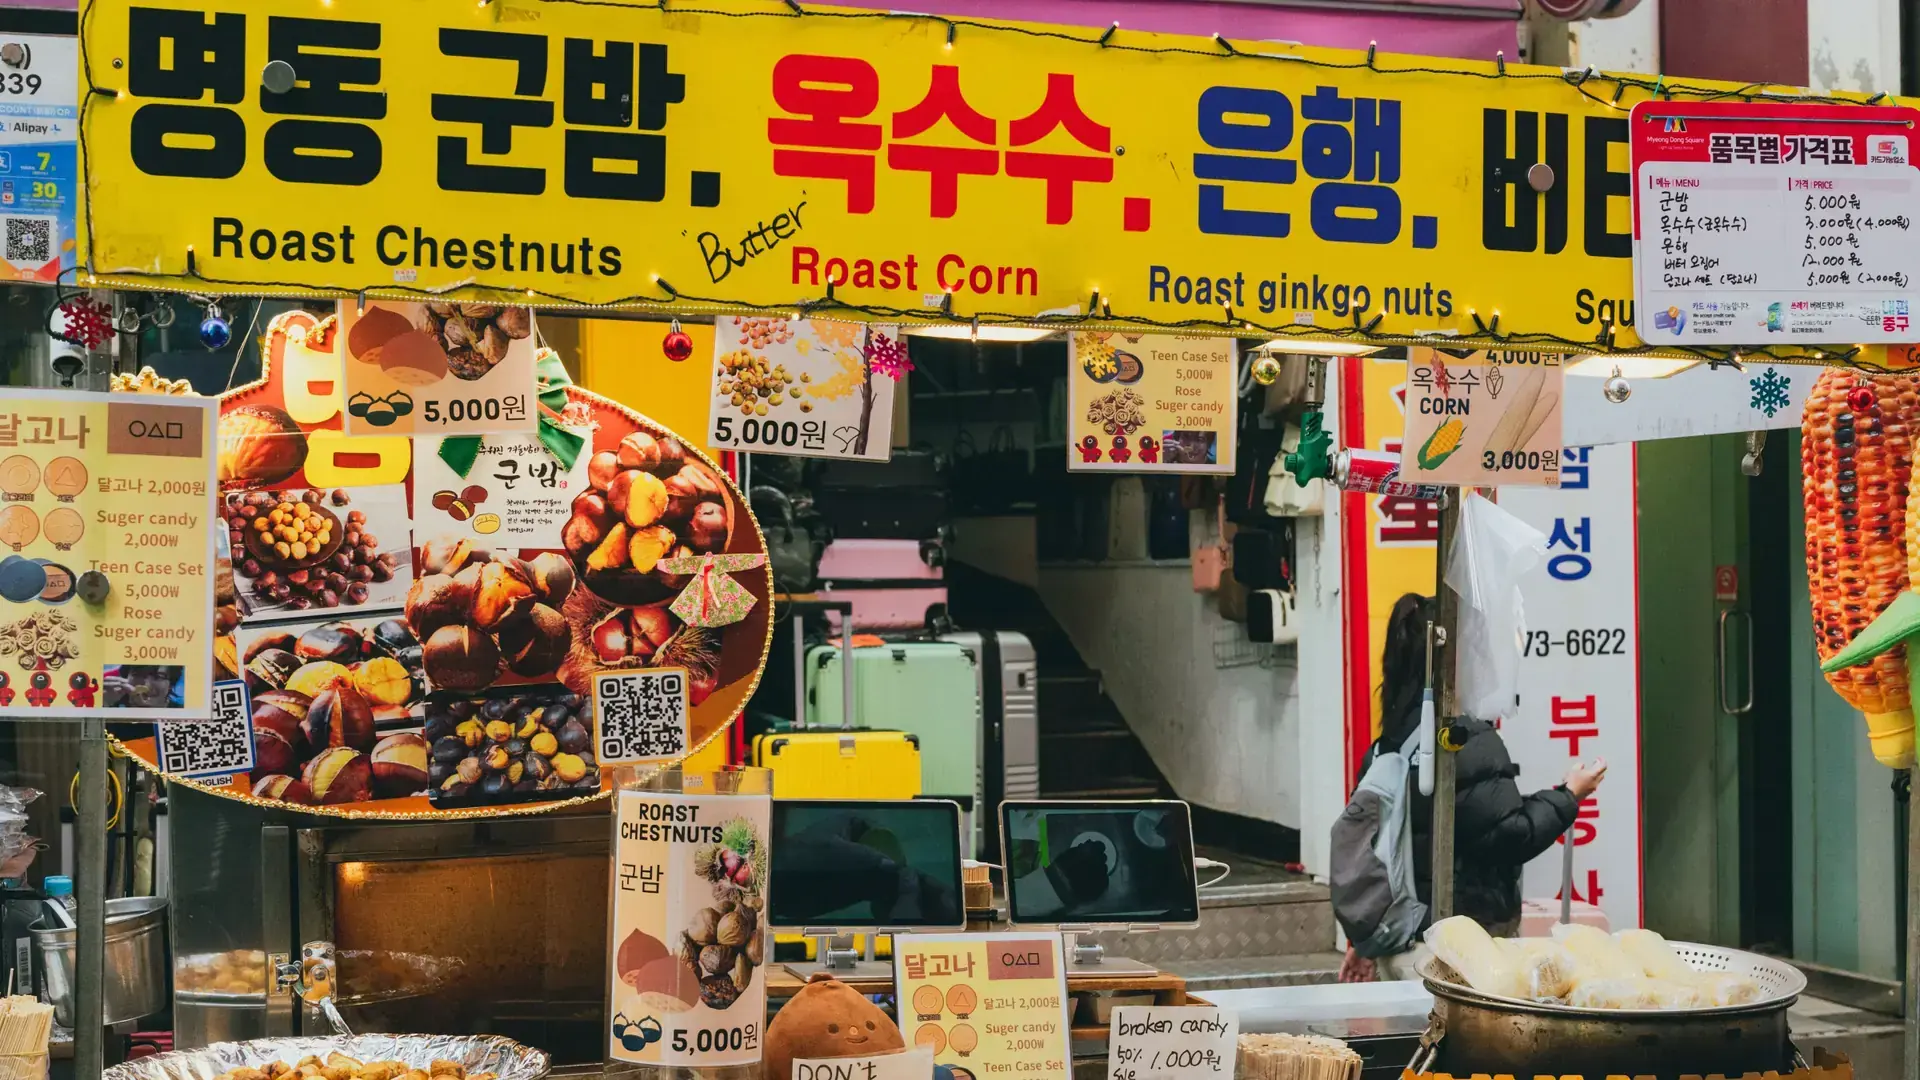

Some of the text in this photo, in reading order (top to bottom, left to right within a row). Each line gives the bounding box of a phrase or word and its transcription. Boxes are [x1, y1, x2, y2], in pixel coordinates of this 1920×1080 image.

[128, 5, 388, 187] 명동
[13, 122, 48, 134] Alipay
[1646, 136, 1669, 144] Myeong
[1710, 135, 1853, 166] 품목별 가격표
[37, 152, 51, 171] 7
[32, 181, 57, 198] 30
[1656, 178, 1700, 188] 메뉴 MENU
[1795, 180, 1833, 190] 가격 PRICE
[1659, 191, 1689, 213] 군밤
[212, 216, 623, 277] Roast Chestnuts
[1661, 235, 1688, 255] 은행
[791, 245, 1040, 297] Roast Corn
[1664, 255, 1720, 271] 버터 오징어
[1149, 265, 1453, 319] Roast ginkgo nuts
[1882, 316, 1910, 332] 중구
[1150, 350, 1229, 363] Teen Case Set
[1174, 385, 1202, 396] Rose
[424, 394, 527, 425] 5,000원
[1155, 400, 1224, 414] Suger candy
[1419, 397, 1470, 416] CORN
[0, 412, 91, 450] 달고나
[714, 417, 827, 450] 5,000원
[1482, 449, 1560, 472] 3,000원
[493, 459, 564, 490] 군밤
[97, 477, 206, 497] 달고나 2,000원
[96, 509, 198, 530] Suger candy
[89, 559, 204, 577] Teen Case Set
[123, 606, 163, 620] Rose
[94, 625, 196, 642] Suger candy
[192, 776, 233, 788] NGLISH
[639, 803, 700, 823] ROAST
[620, 822, 724, 844] CHESTNUTS
[619, 863, 665, 895] 군밤
[904, 951, 976, 980] 달고나
[983, 995, 1060, 1011] 달고나 2,000원
[985, 1021, 1056, 1036] Suger candy
[1118, 1011, 1229, 1038] broken candy
[671, 1021, 758, 1056] 5,000원
[1117, 1044, 1143, 1065] 50%
[983, 1060, 1064, 1073] Teen Case Set
